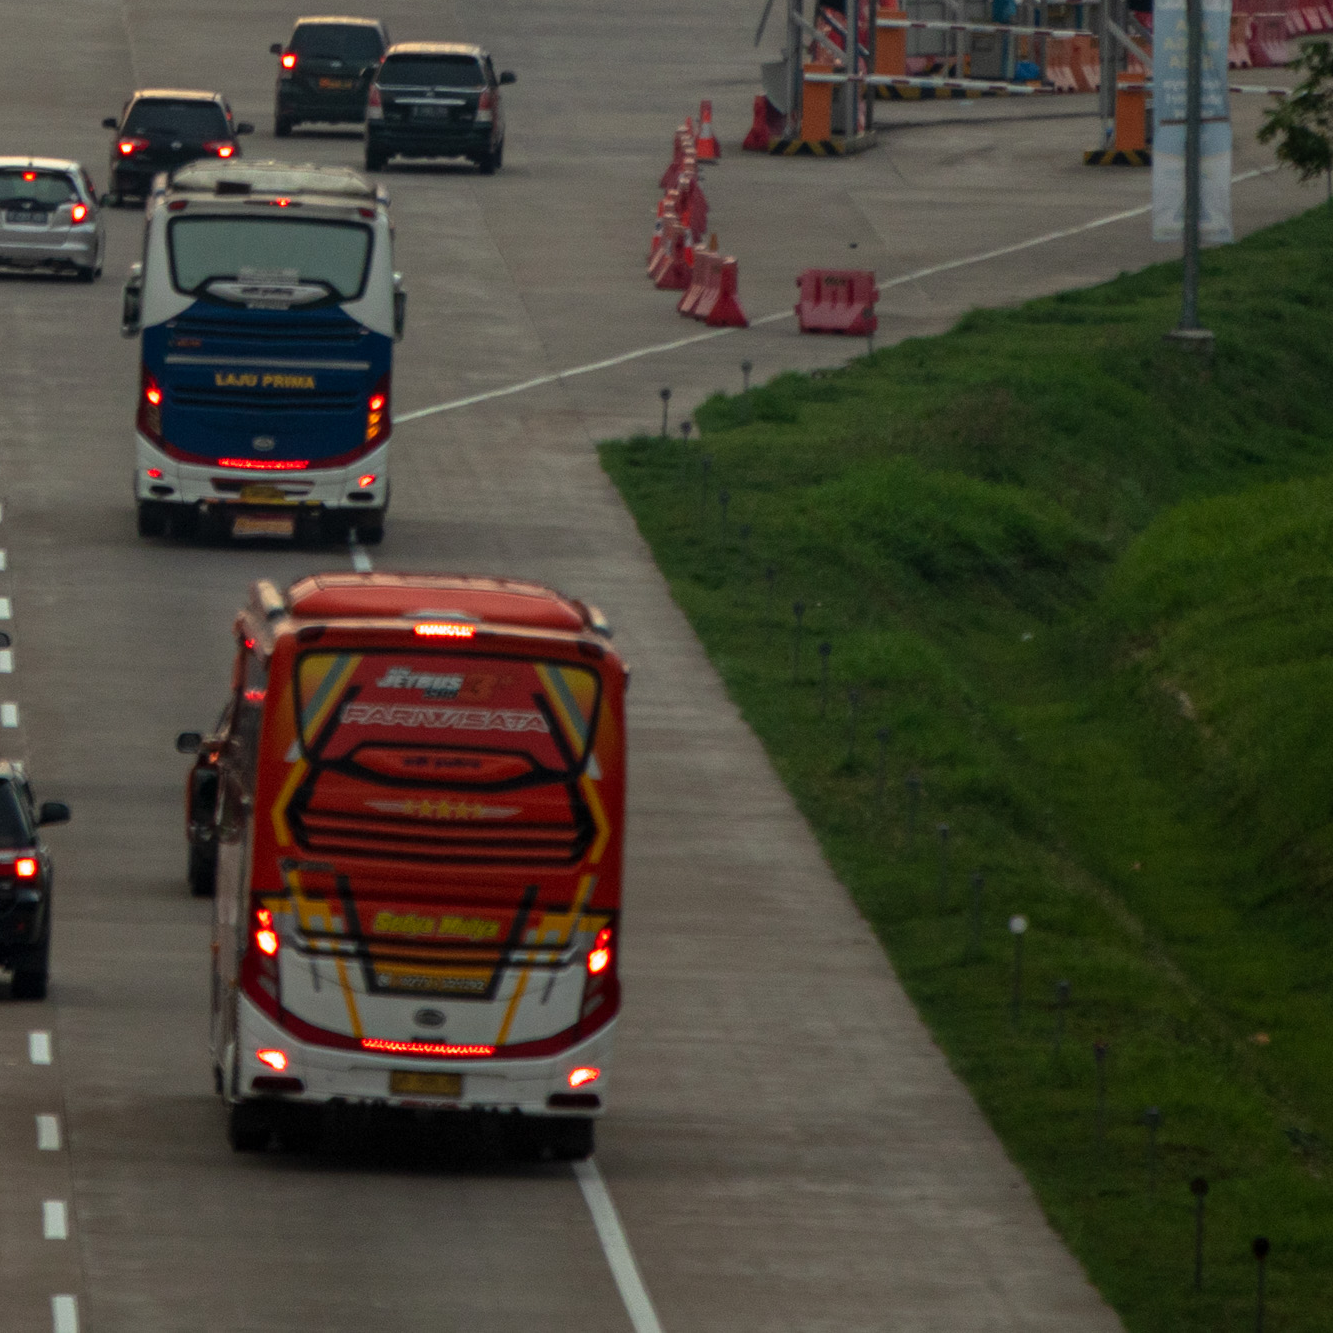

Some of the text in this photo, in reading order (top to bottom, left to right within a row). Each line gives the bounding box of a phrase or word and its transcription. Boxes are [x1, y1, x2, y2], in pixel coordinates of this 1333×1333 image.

[215, 372, 316, 390] LAJU PRIMA
[339, 702, 551, 734] PARIWISATA
